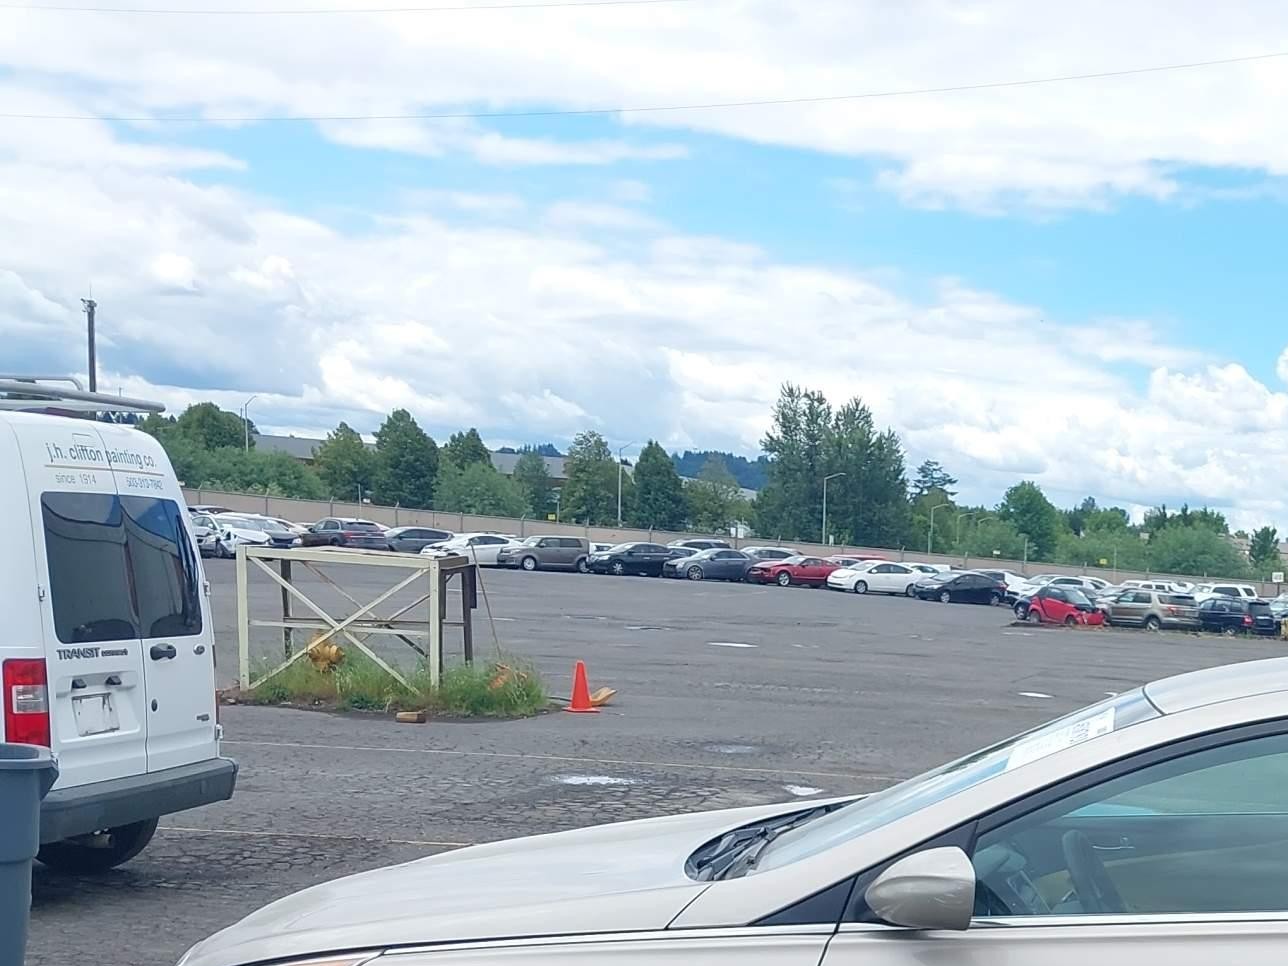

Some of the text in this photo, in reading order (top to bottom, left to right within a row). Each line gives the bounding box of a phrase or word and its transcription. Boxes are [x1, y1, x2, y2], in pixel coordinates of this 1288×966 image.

[45, 442, 157, 469] j.h. clifton painting co.
[55, 472, 76, 484] since
[56, 647, 101, 661] TRANSIT
